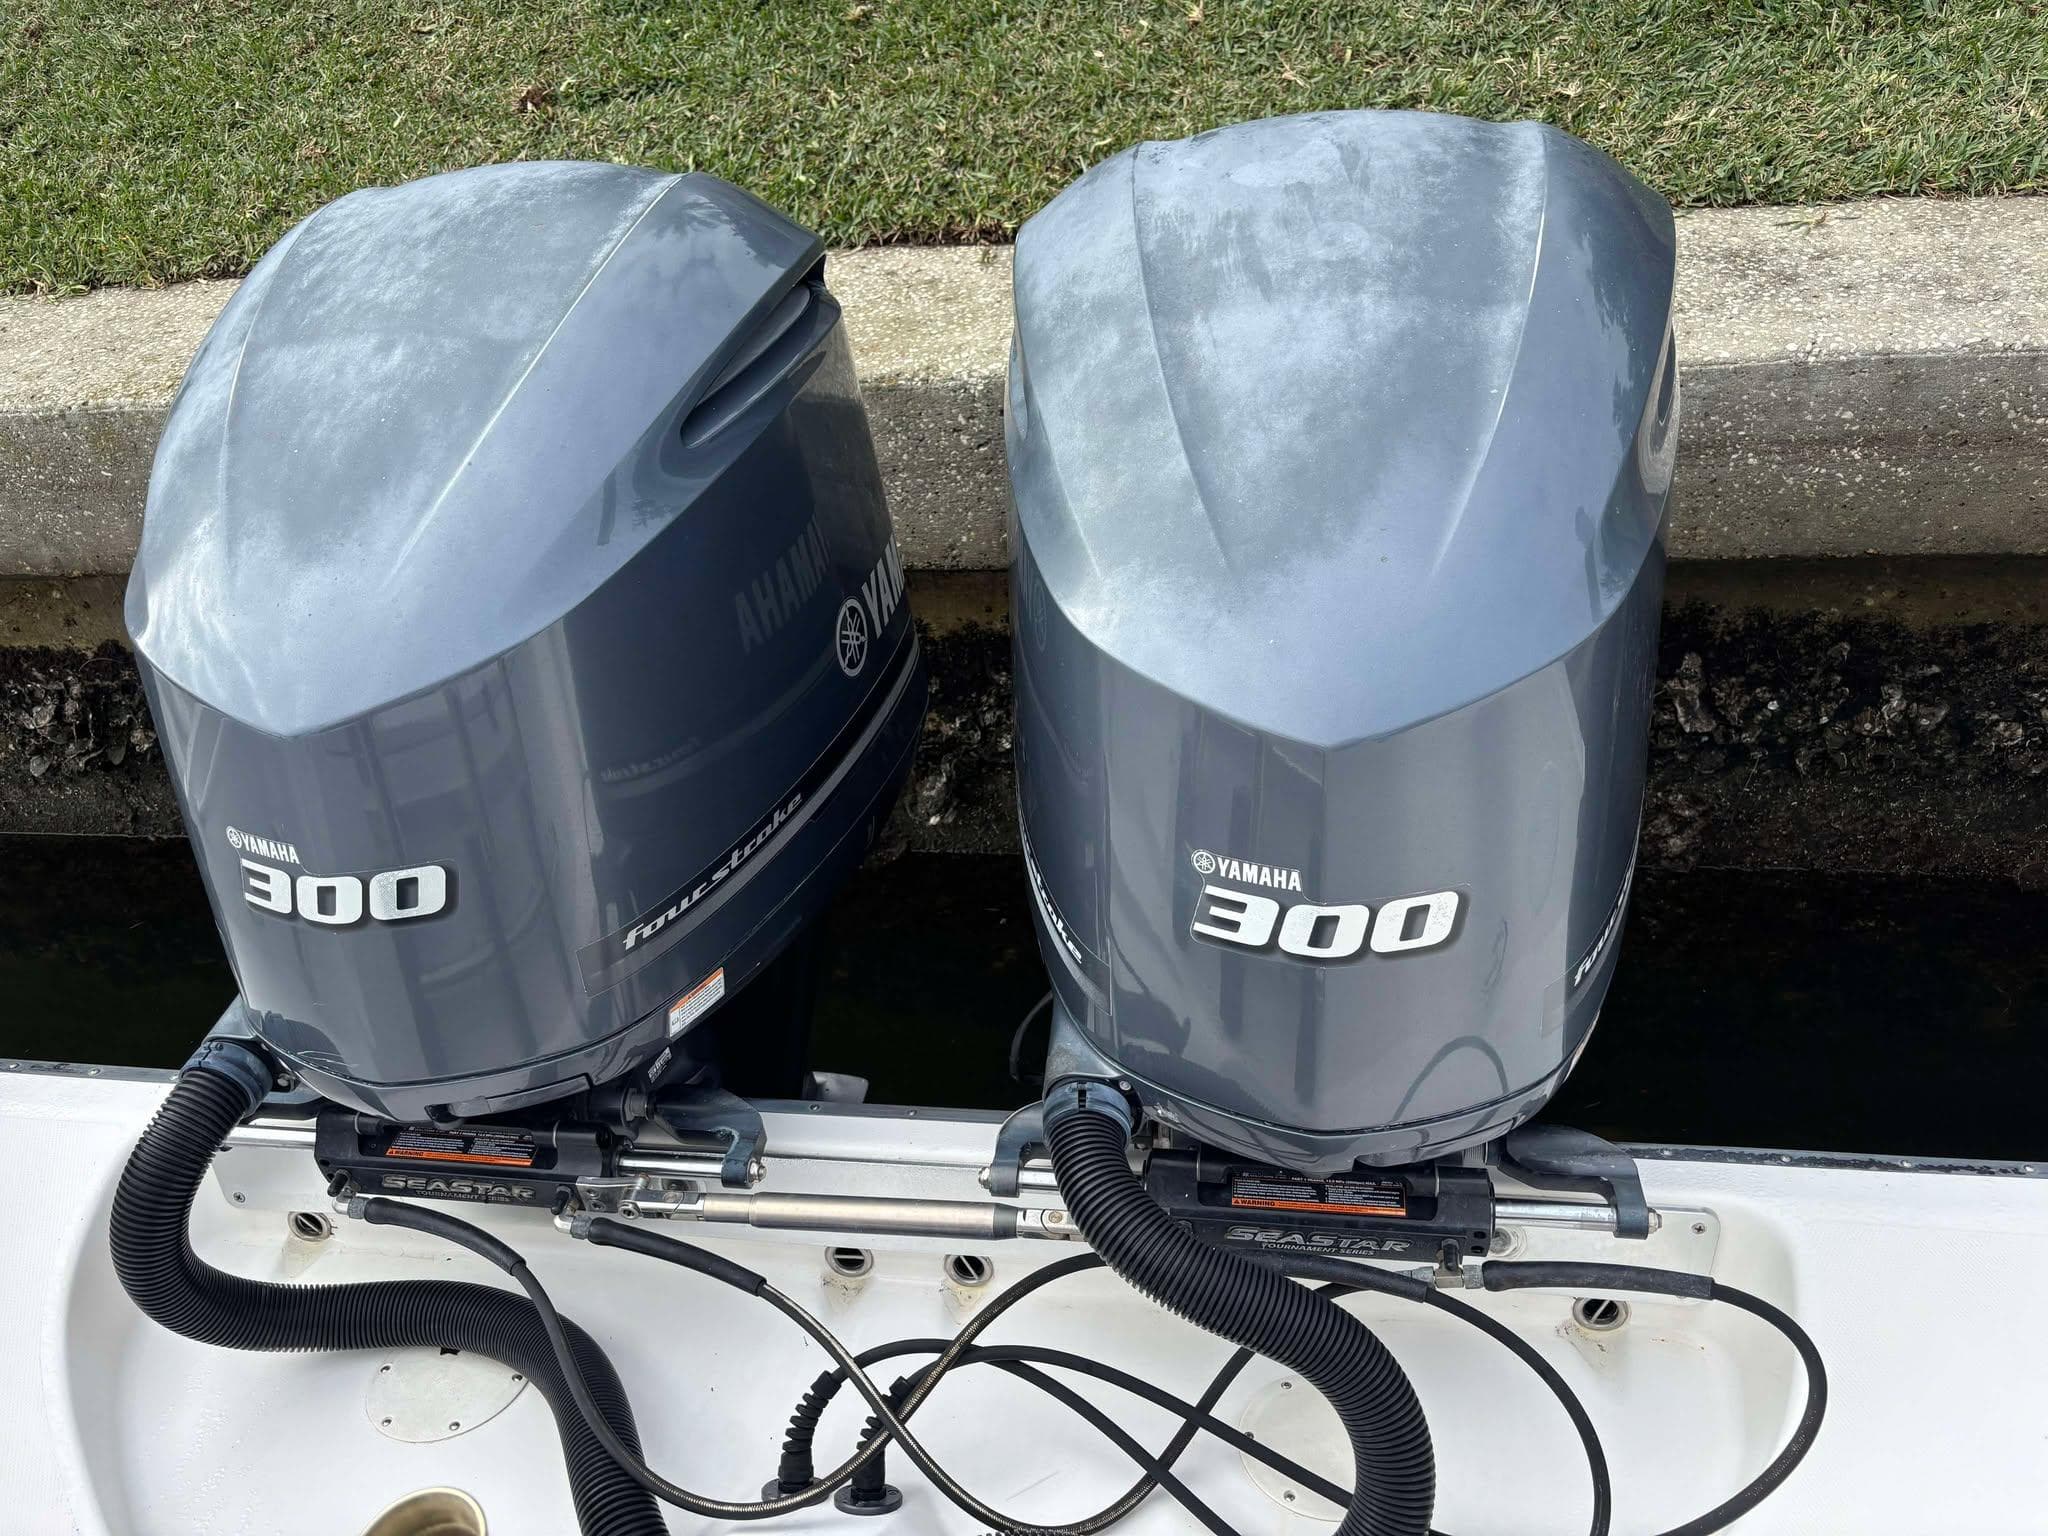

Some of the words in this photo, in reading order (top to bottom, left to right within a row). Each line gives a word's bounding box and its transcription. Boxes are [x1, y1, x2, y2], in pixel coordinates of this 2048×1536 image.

[861, 532, 905, 640] YAM
[241, 833, 300, 864] YAMAHA
[1217, 857, 1301, 892] YAMAHA
[240, 858, 447, 925] 300
[1193, 884, 1459, 958] 300
[382, 1173, 536, 1200] SEASTAR
[1240, 1199, 1276, 1207] WARNING
[1225, 1227, 1411, 1252] SEASTAR
[1262, 1242, 1336, 1254] TOURNAMENT
[1339, 1248, 1375, 1257] SERIES
